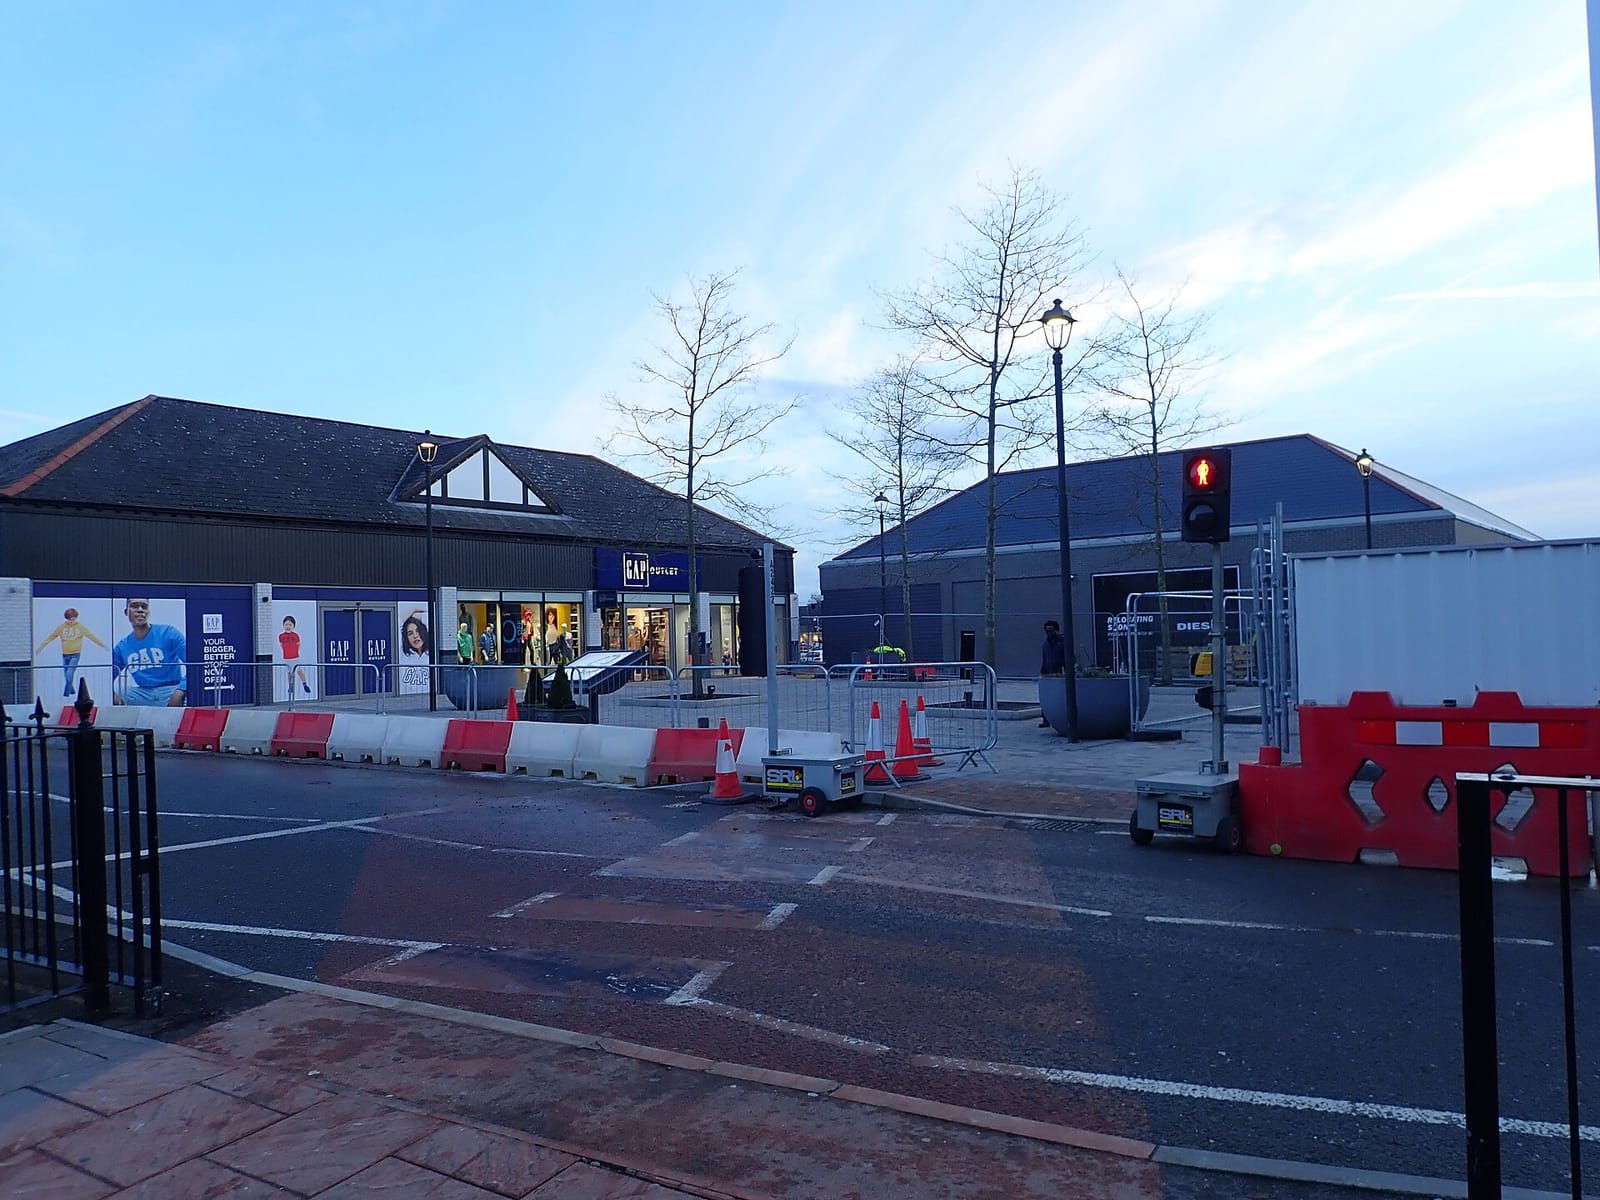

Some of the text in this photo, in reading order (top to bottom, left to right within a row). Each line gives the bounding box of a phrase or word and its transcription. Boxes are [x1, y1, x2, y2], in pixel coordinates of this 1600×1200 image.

[626, 560, 678, 579] GAP OUTLET
[62, 627, 81, 639] GAP
[330, 641, 349, 657] GAP
[368, 640, 386, 656] GAP
[127, 647, 165, 673] GAP
[767, 769, 802, 784] SRL
[1160, 808, 1192, 821] SRL
